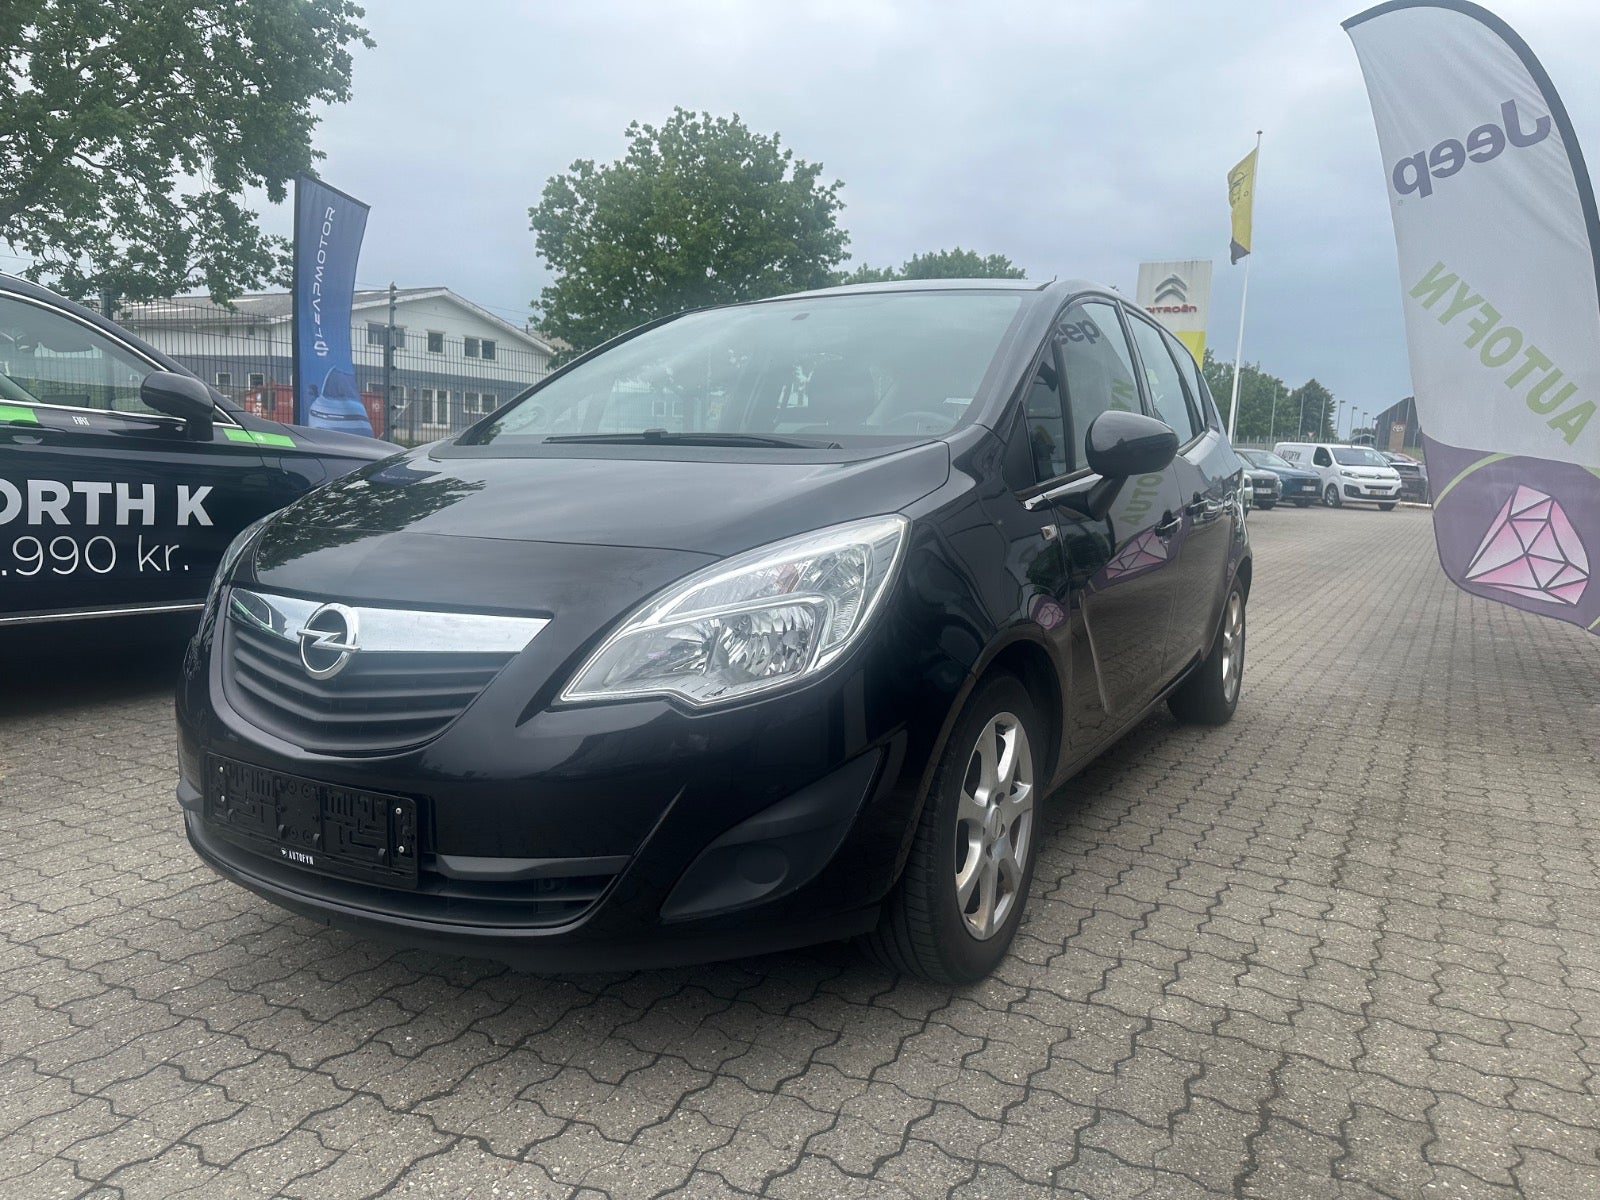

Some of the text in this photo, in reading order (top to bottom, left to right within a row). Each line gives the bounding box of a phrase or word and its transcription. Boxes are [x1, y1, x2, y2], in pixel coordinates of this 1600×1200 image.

[314, 206, 337, 338] LEAPMOTOR
[71, 415, 90, 426] FIAT
[177, 485, 214, 526] K
[137, 534, 189, 573] kr.
[288, 850, 314, 865] AUTOFYN
